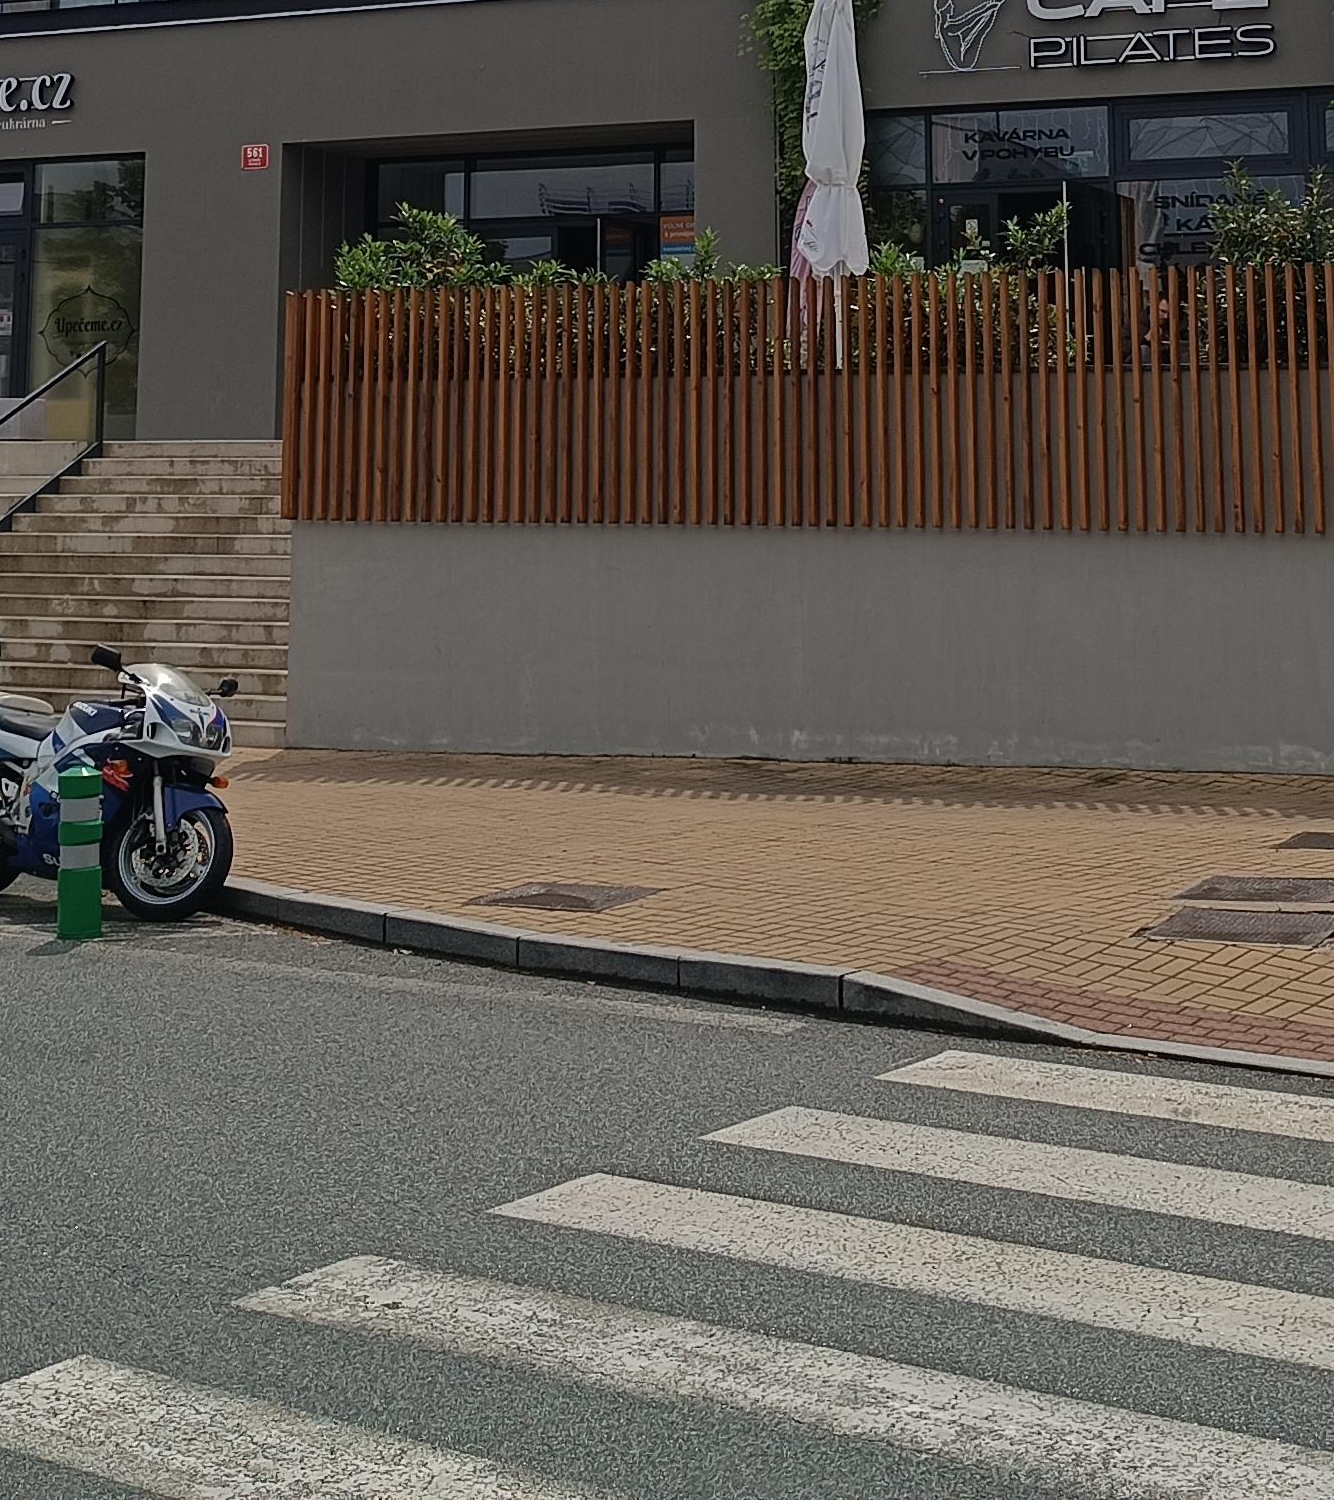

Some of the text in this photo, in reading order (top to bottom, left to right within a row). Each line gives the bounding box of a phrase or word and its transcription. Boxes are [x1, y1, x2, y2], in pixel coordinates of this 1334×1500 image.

[1028, 24, 1276, 68] PILATES
[963, 128, 1071, 144] KAVÁRNA
[247, 147, 262, 158] 561
[962, 145, 1075, 161] V POHYBU
[54, 316, 123, 337] Upečeme.cz
